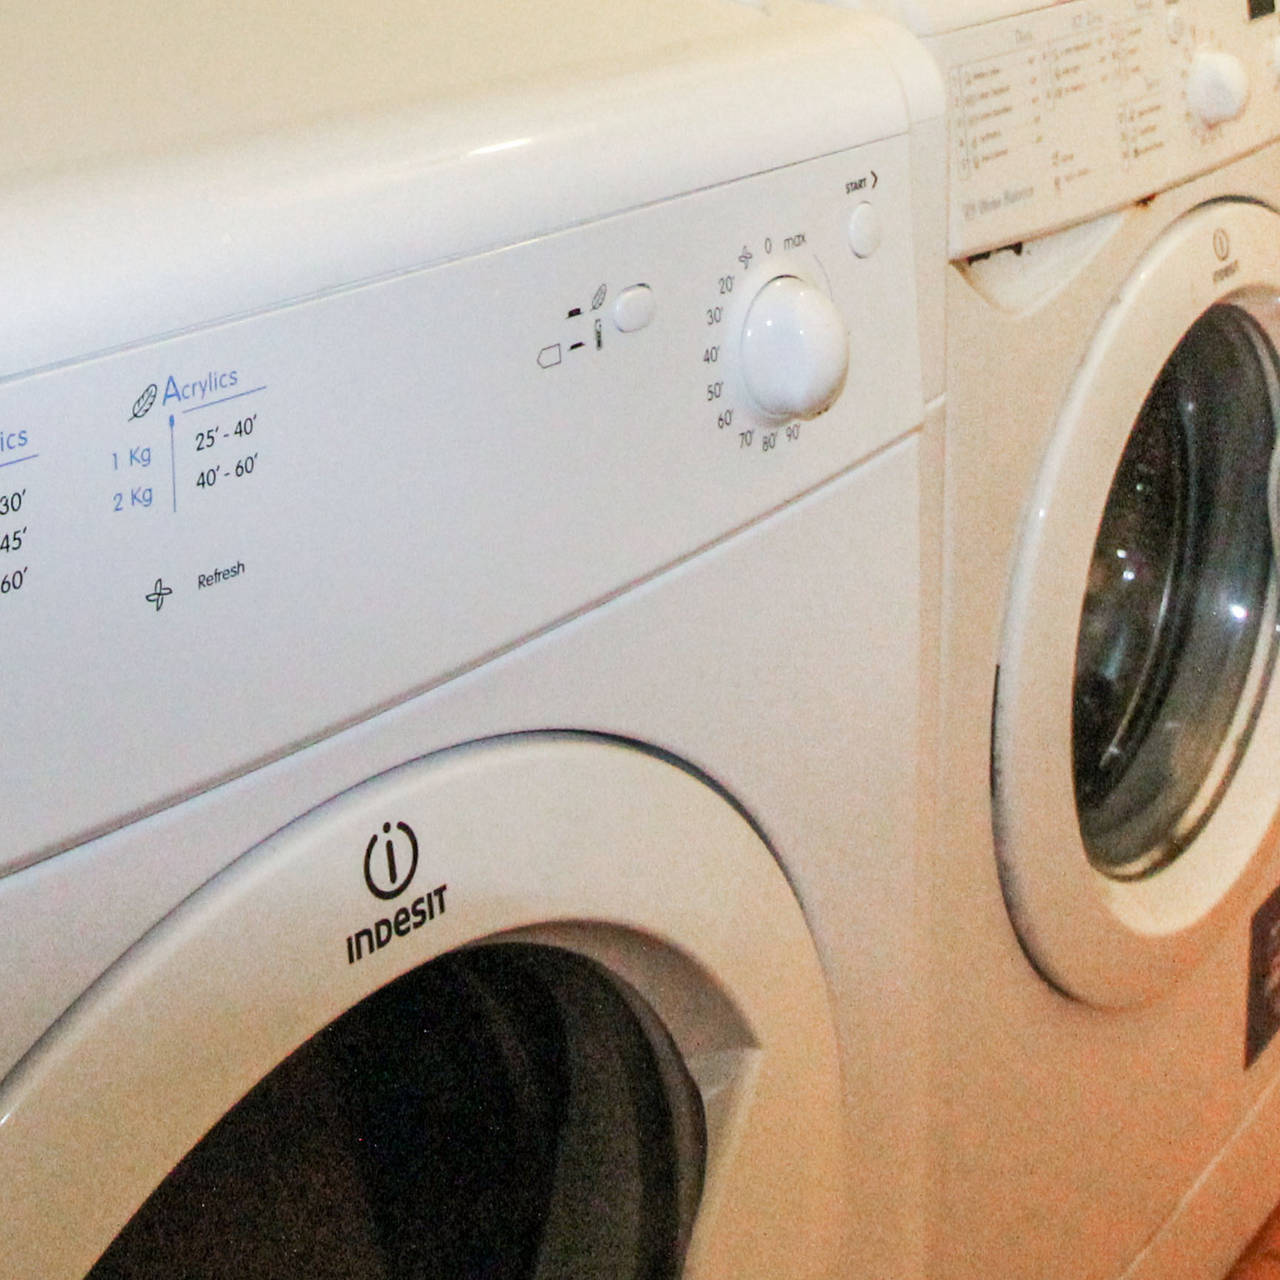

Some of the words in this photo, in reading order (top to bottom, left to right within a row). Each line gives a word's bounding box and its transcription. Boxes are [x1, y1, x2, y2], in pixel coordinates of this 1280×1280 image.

[784, 233, 806, 248] max
[162, 371, 237, 406] Acrylics
[112, 453, 118, 470] 1
[129, 447, 151, 467] Kg
[113, 493, 123, 512] 2
[131, 488, 153, 507] Kg
[198, 561, 245, 589] Refresh
